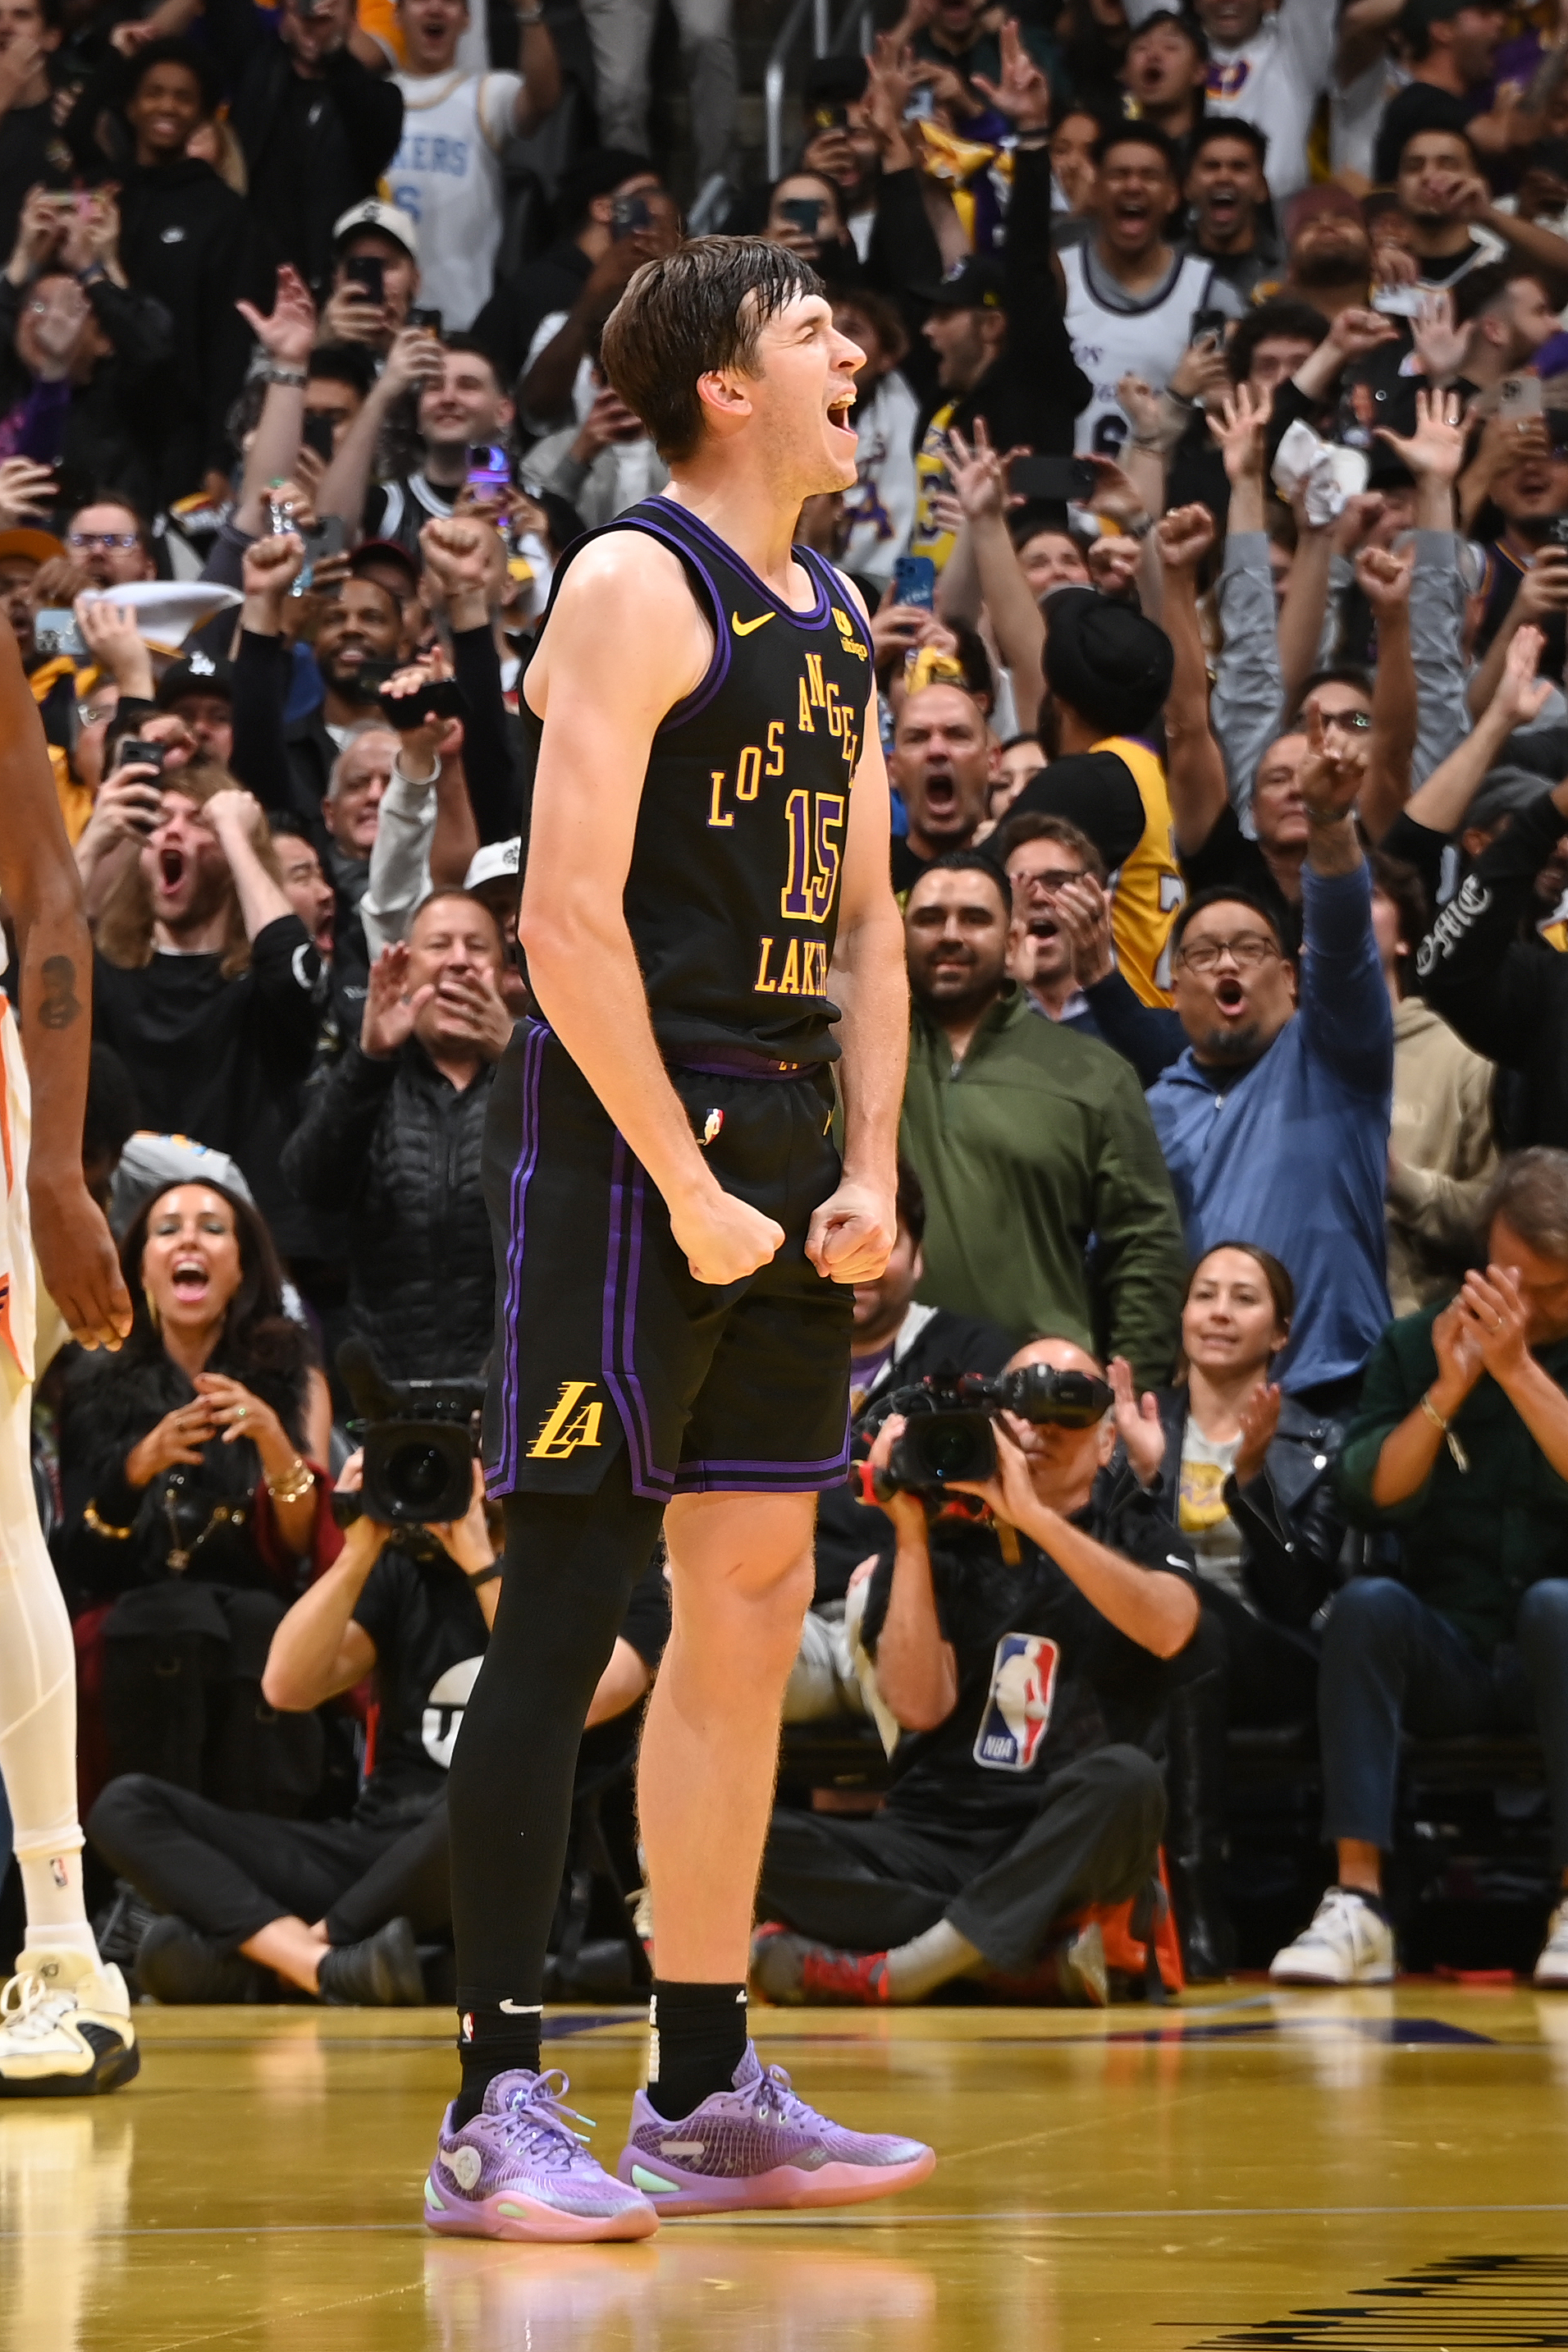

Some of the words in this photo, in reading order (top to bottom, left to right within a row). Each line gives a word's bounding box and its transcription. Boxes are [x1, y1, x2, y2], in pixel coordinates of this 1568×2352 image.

[706, 719, 786, 828] LOS
[781, 789, 845, 924] 15
[525, 1381, 603, 1459] LA
[982, 1734, 1014, 1759] NBA
